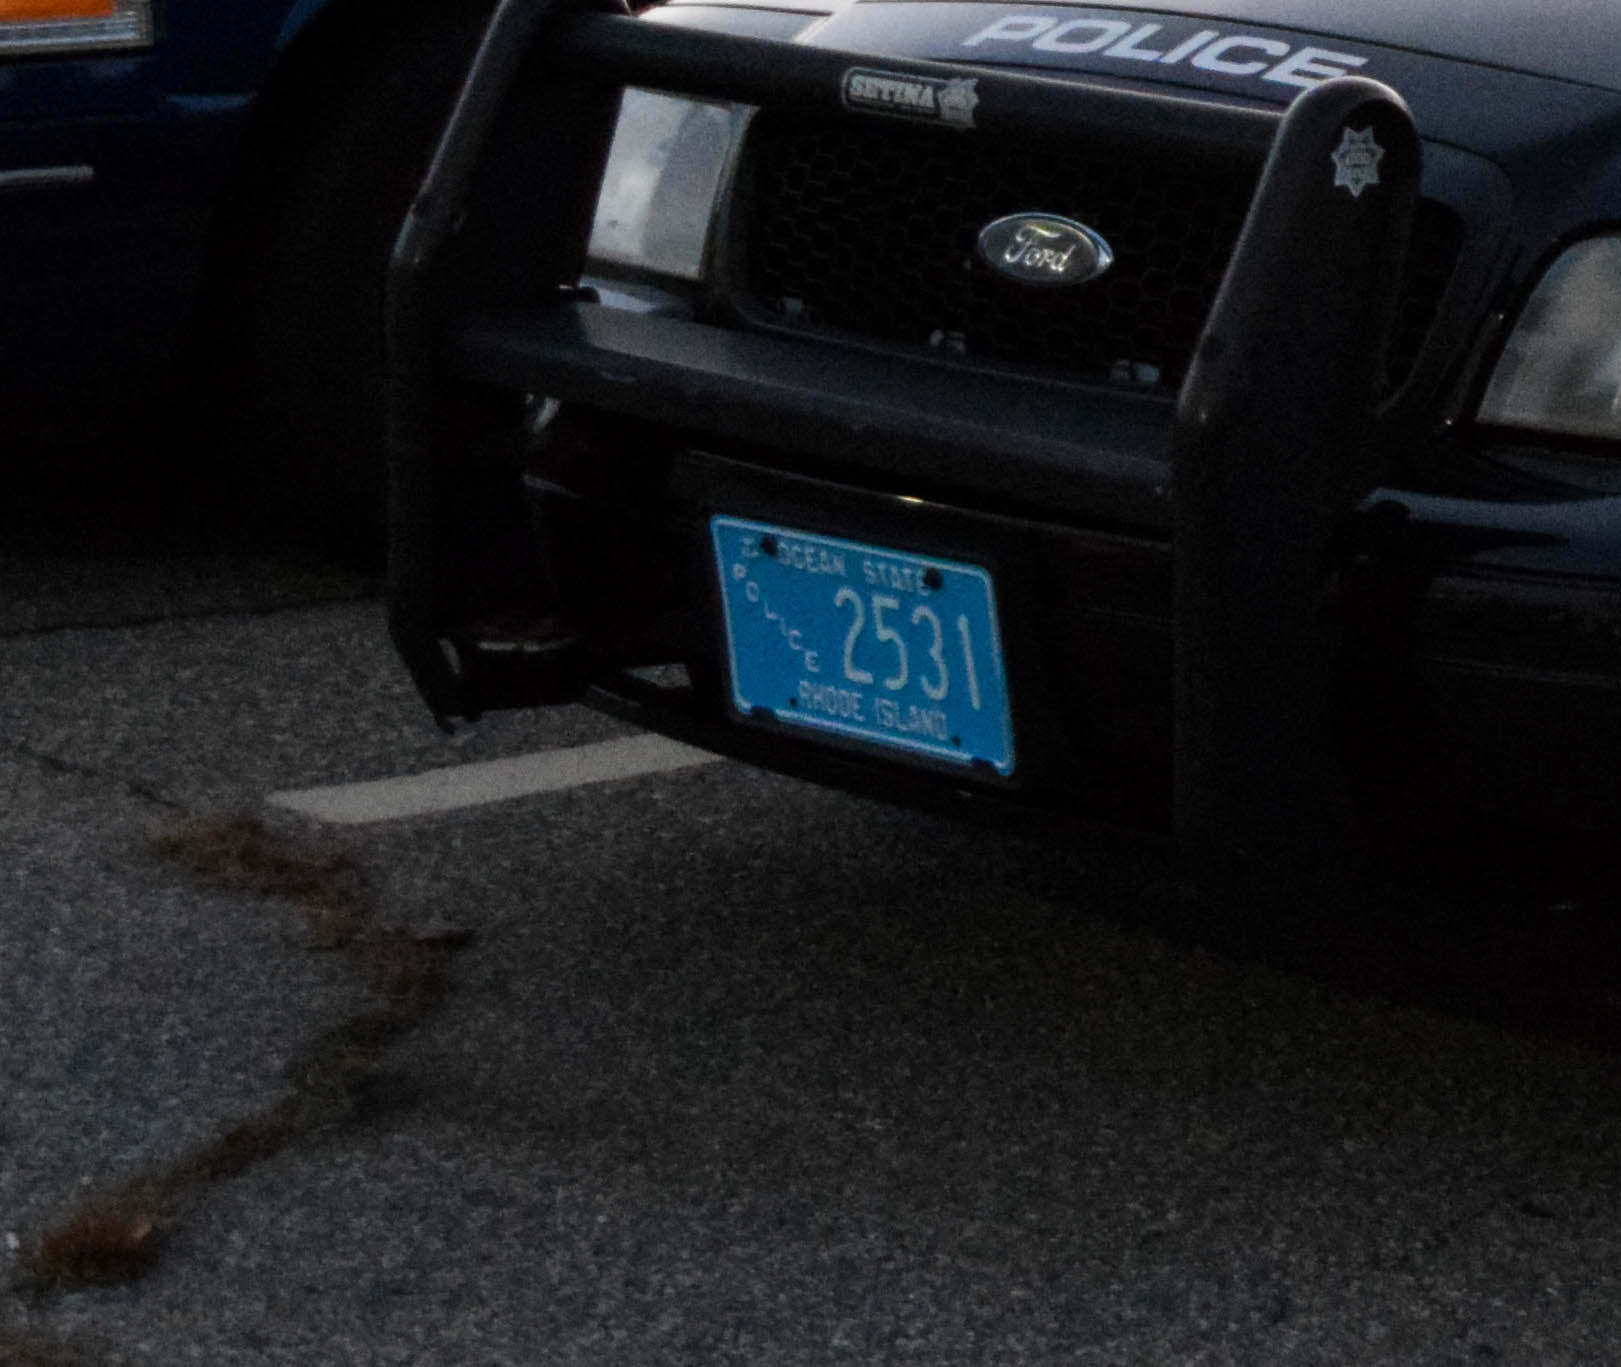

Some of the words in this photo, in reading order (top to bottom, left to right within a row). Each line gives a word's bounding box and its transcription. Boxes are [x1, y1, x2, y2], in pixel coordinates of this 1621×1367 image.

[963, 14, 1369, 88] POLICE
[1003, 223, 1077, 273] Ford
[834, 585, 982, 712] 2531
[798, 679, 867, 722] RHODE
[874, 696, 949, 741] ISLAND
